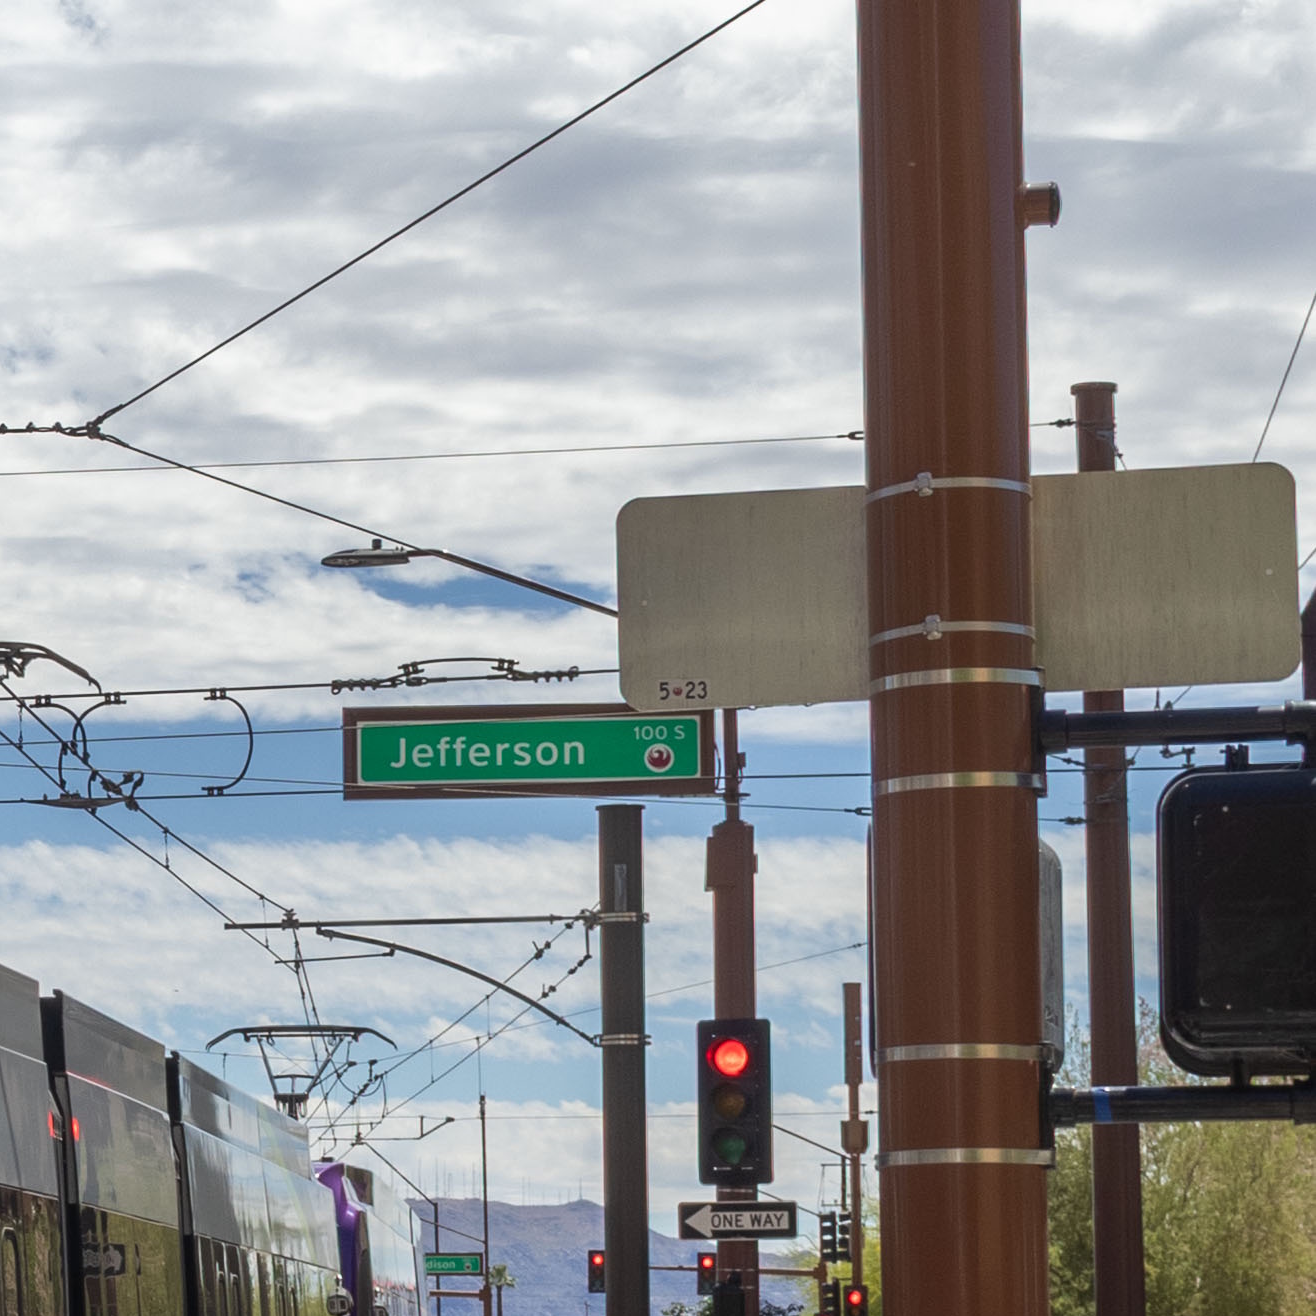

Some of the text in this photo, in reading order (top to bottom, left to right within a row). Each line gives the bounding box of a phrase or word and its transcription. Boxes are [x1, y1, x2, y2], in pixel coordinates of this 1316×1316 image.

[633, 725, 685, 740] 100 S
[390, 737, 585, 768] Jefferson
[711, 1212, 784, 1229] ONE WAY
